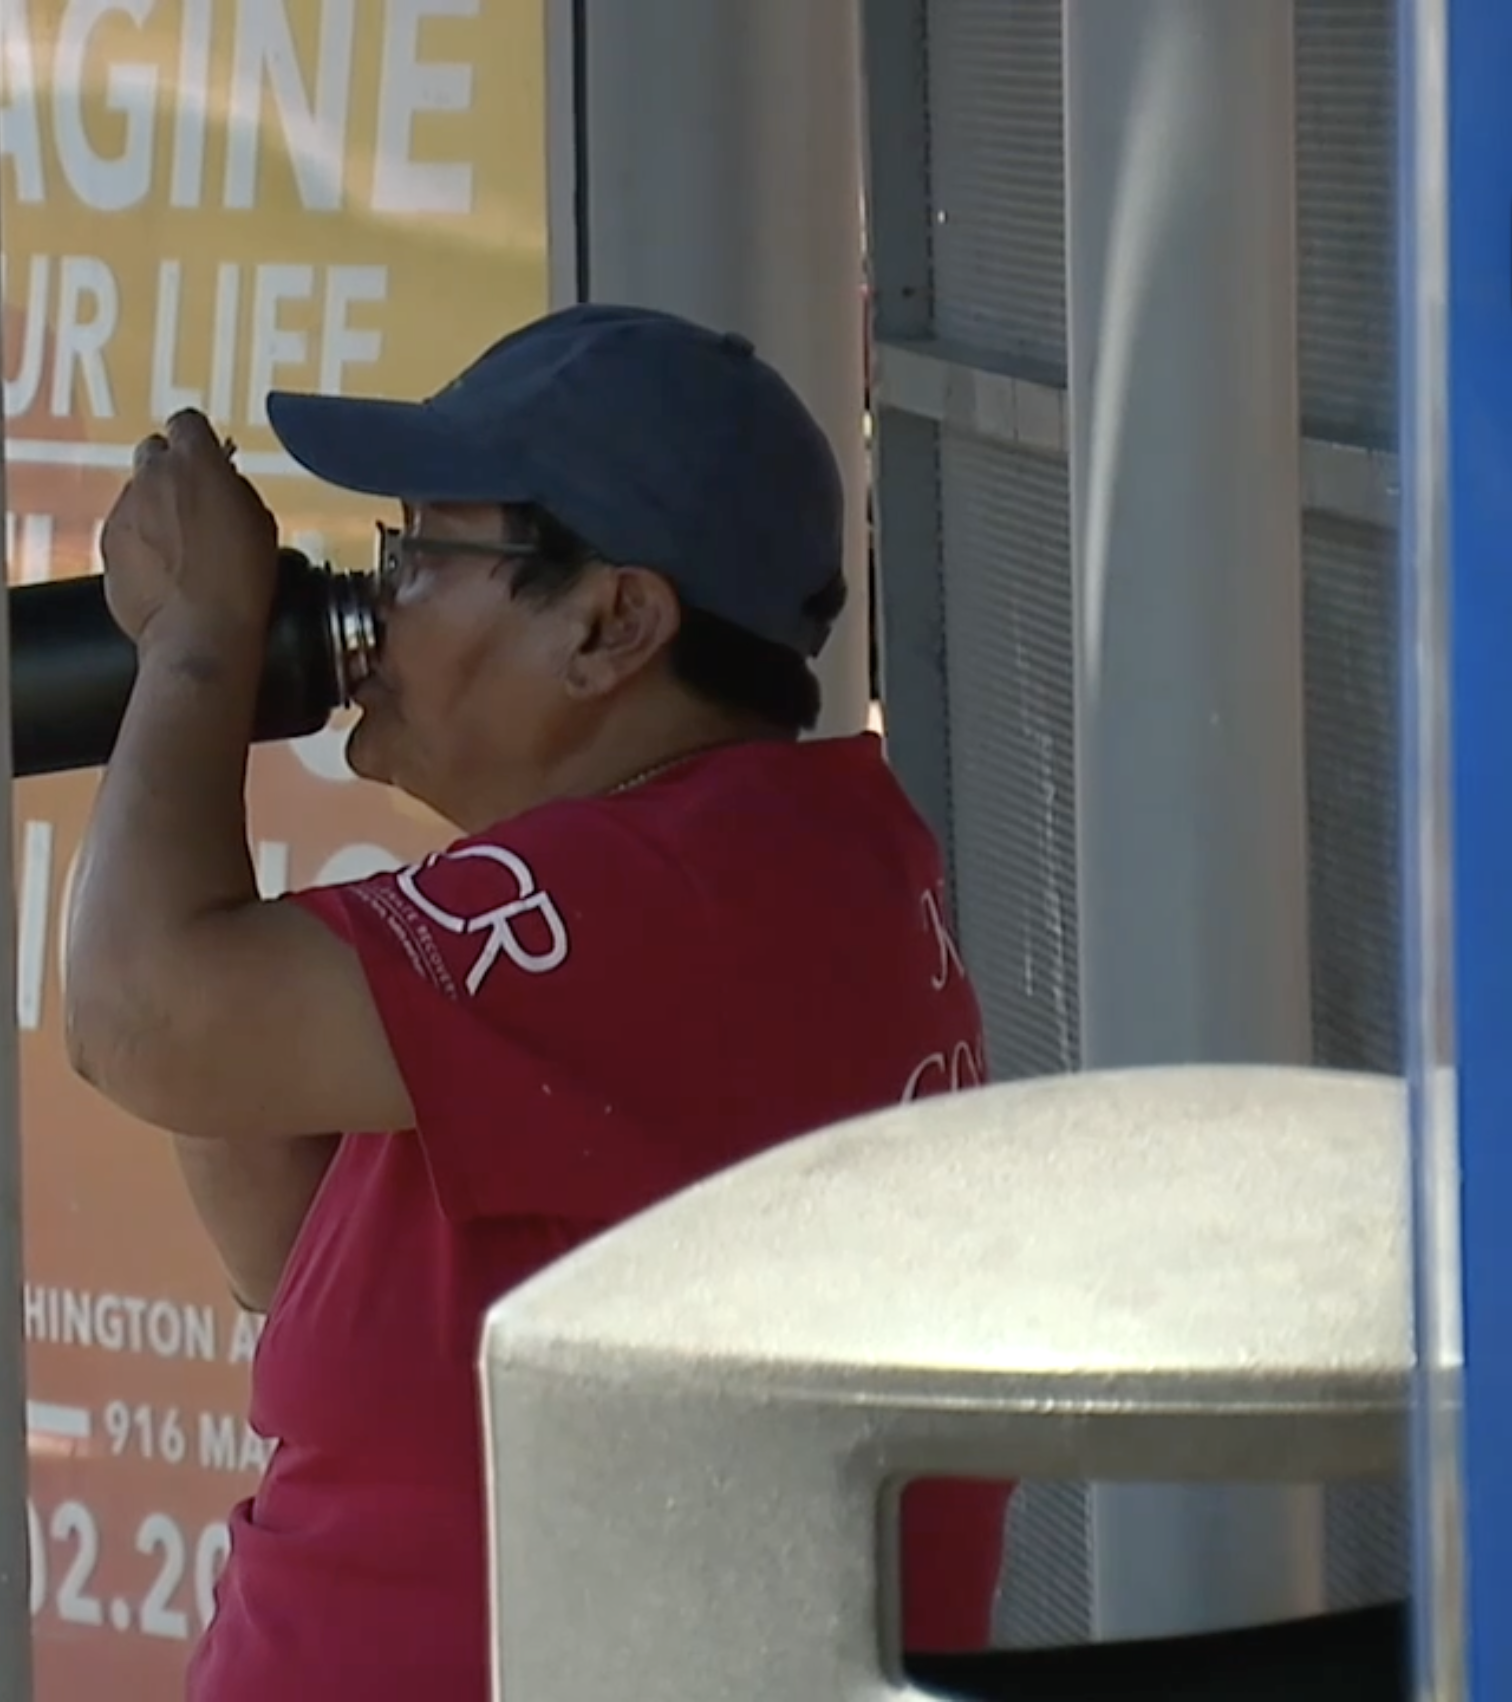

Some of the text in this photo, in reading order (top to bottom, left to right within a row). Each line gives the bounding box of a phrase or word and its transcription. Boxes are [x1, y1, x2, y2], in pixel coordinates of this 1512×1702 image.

[1, 253, 120, 420] UR
[24, 1282, 215, 1362] HINGTON
[105, 1399, 185, 1462] 916
